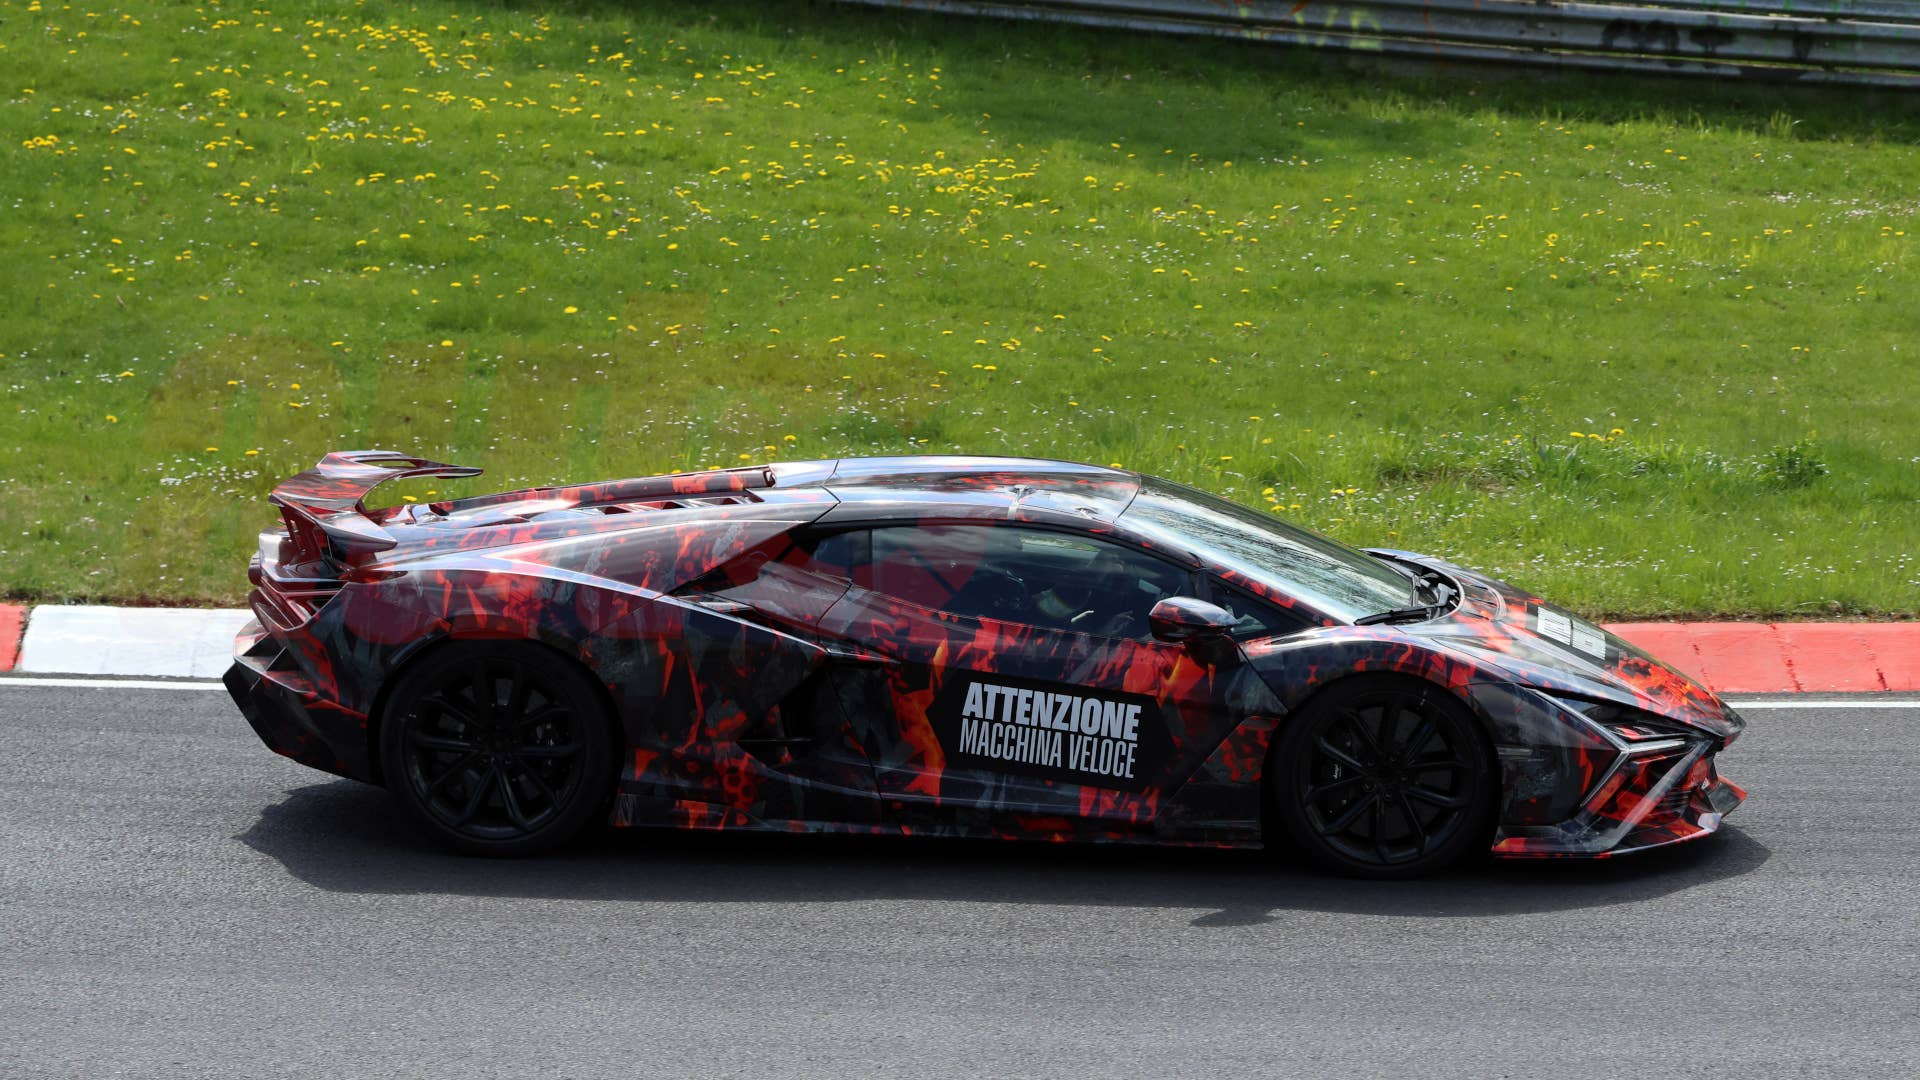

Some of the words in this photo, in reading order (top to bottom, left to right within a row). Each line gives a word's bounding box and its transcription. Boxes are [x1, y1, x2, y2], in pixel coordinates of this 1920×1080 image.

[962, 682, 1142, 741] ATTENZIONE
[960, 719, 1062, 768] MACCHINA
[1069, 733, 1138, 779] VELOCE
